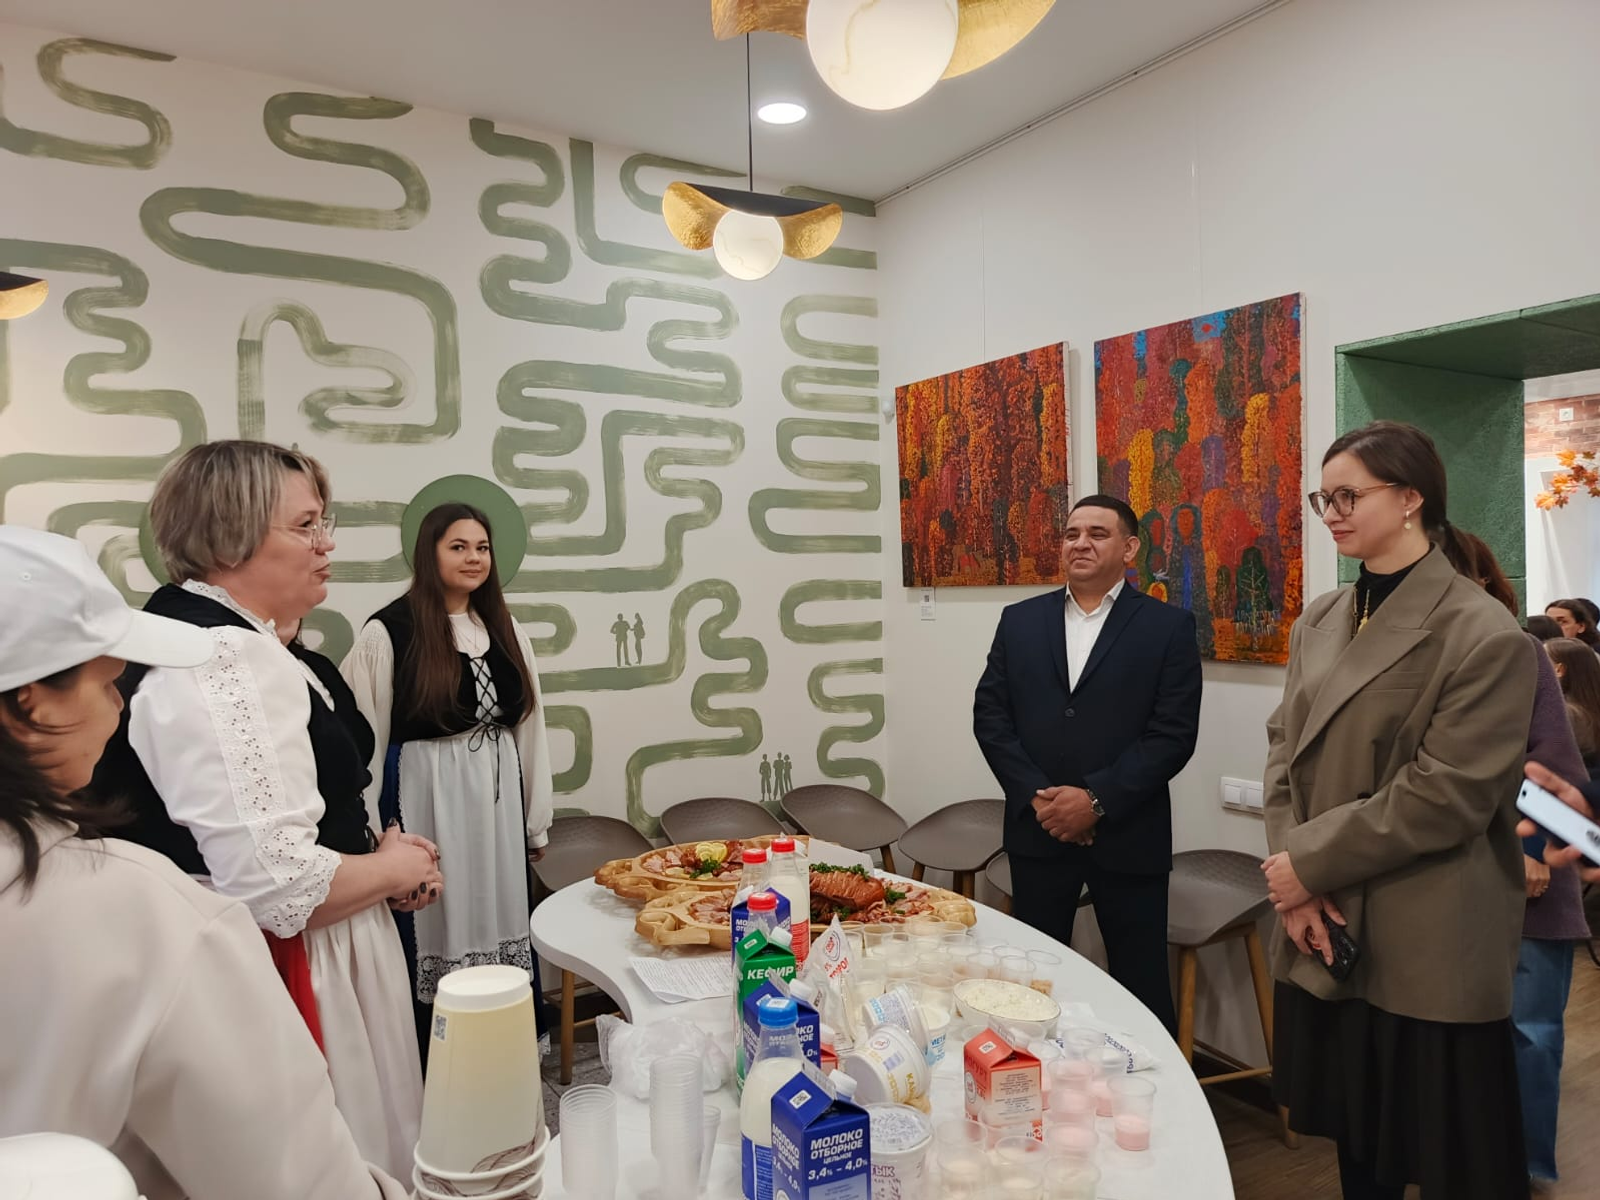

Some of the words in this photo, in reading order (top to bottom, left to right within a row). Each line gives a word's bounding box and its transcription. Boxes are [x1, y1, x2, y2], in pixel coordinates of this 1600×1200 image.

[772, 1123, 799, 1159] МОЛОКО
[810, 1128, 863, 1151] МОЛОКО
[810, 1138, 863, 1160] ОТБОРНОЕ
[808, 1167, 833, 1180] 3,4%
[845, 1157, 868, 1171] 4,0%
[823, 1151, 853, 1164] ЦЕЛЬНОЕ
